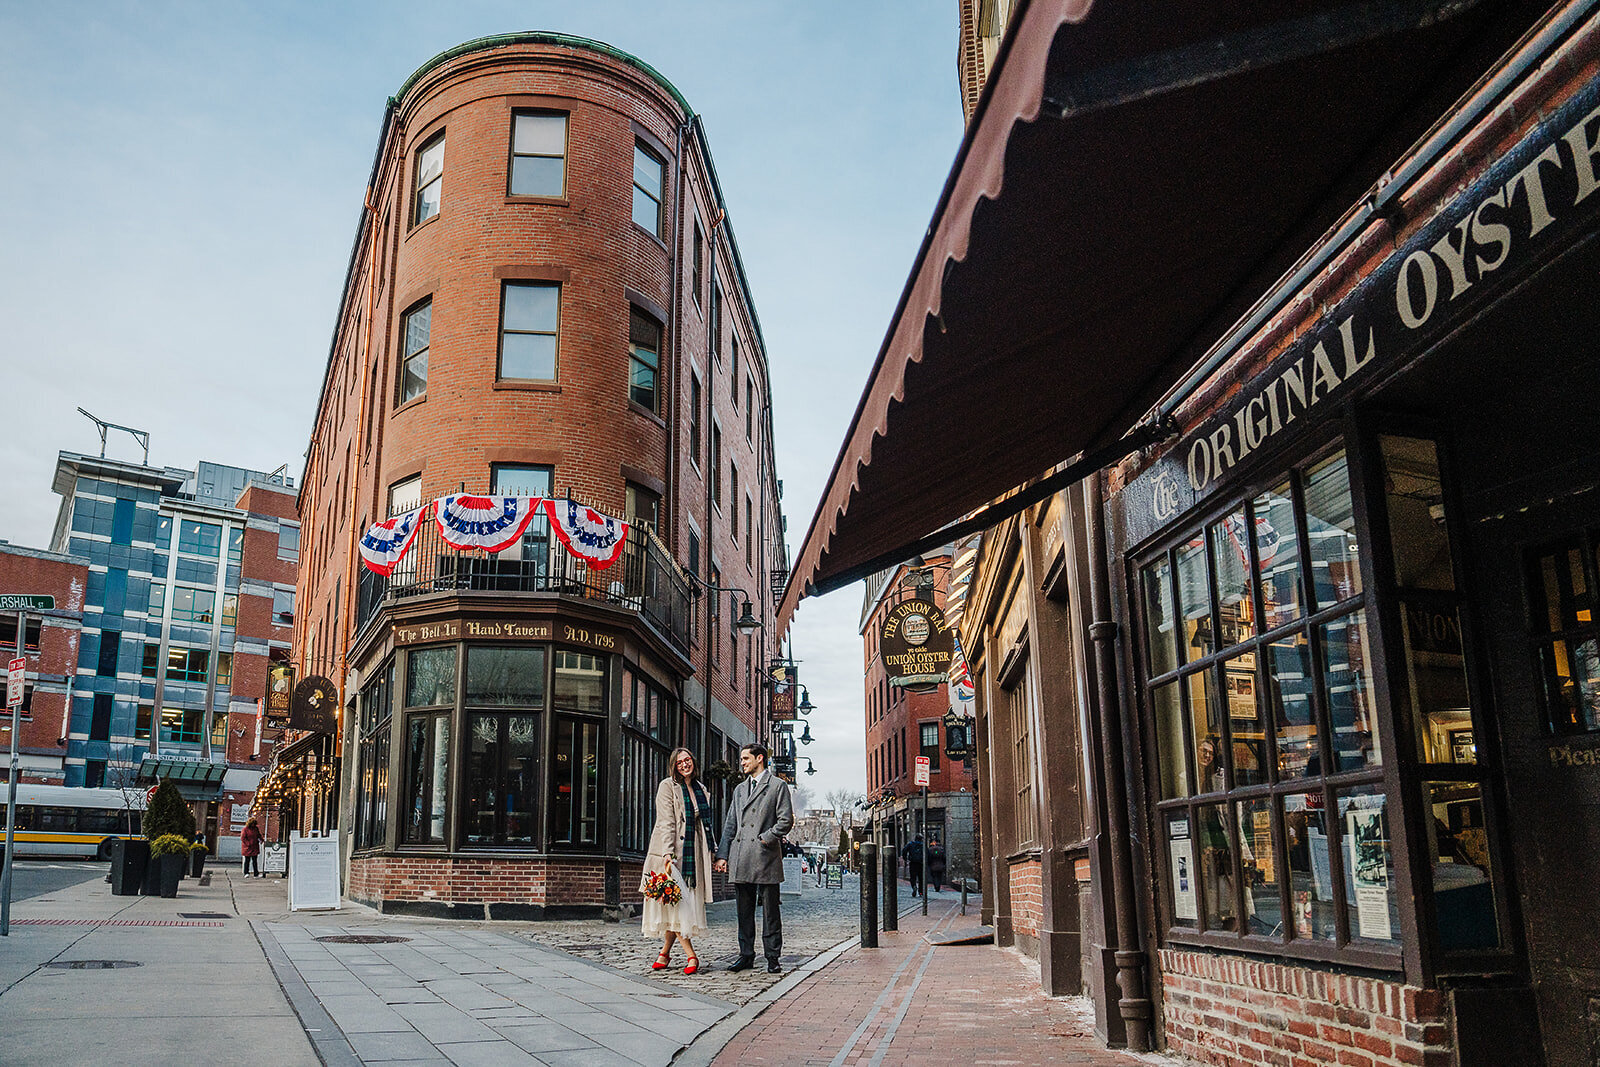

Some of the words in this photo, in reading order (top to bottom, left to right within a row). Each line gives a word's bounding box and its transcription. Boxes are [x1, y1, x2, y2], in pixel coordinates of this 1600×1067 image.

[1150, 470, 1178, 522] The
[1187, 313, 1376, 492] ORIGINAL
[0, 596, 36, 608] RSHALL
[884, 616, 900, 638] THE
[896, 602, 932, 617] UNION
[929, 611, 947, 635] BAR
[398, 629, 417, 643] The
[420, 625, 440, 639] Bell
[466, 622, 501, 636] Hand
[503, 623, 548, 636] Tavern
[563, 624, 591, 645] A.D.
[594, 633, 615, 649] 1795
[886, 653, 916, 666] UNION
[916, 651, 951, 663] OYSTER
[902, 662, 936, 675] HOUSE
